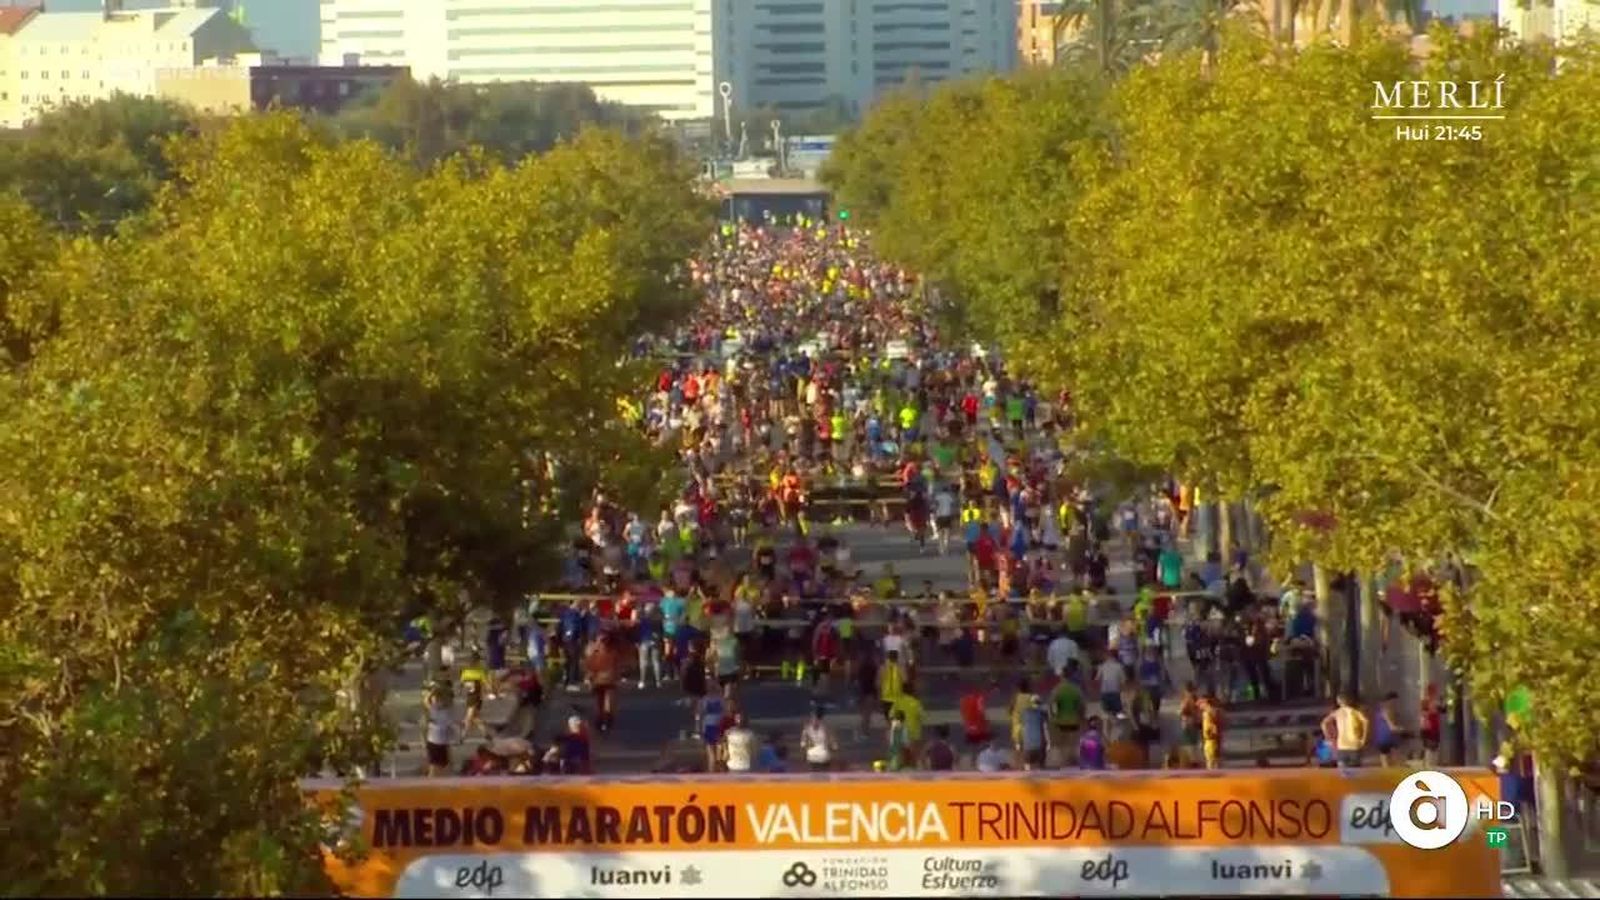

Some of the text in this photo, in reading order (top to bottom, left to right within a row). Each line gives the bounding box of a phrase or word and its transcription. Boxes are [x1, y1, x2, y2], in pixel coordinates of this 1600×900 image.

[373, 794, 1332, 848] MEDIO MARATÓN VALENCIA TRINIDAD ALFONSO
[455, 860, 504, 890] edp
[923, 856, 983, 874] Cultura
[1080, 855, 1129, 888] edp
[921, 872, 999, 890] Esfuerzo
